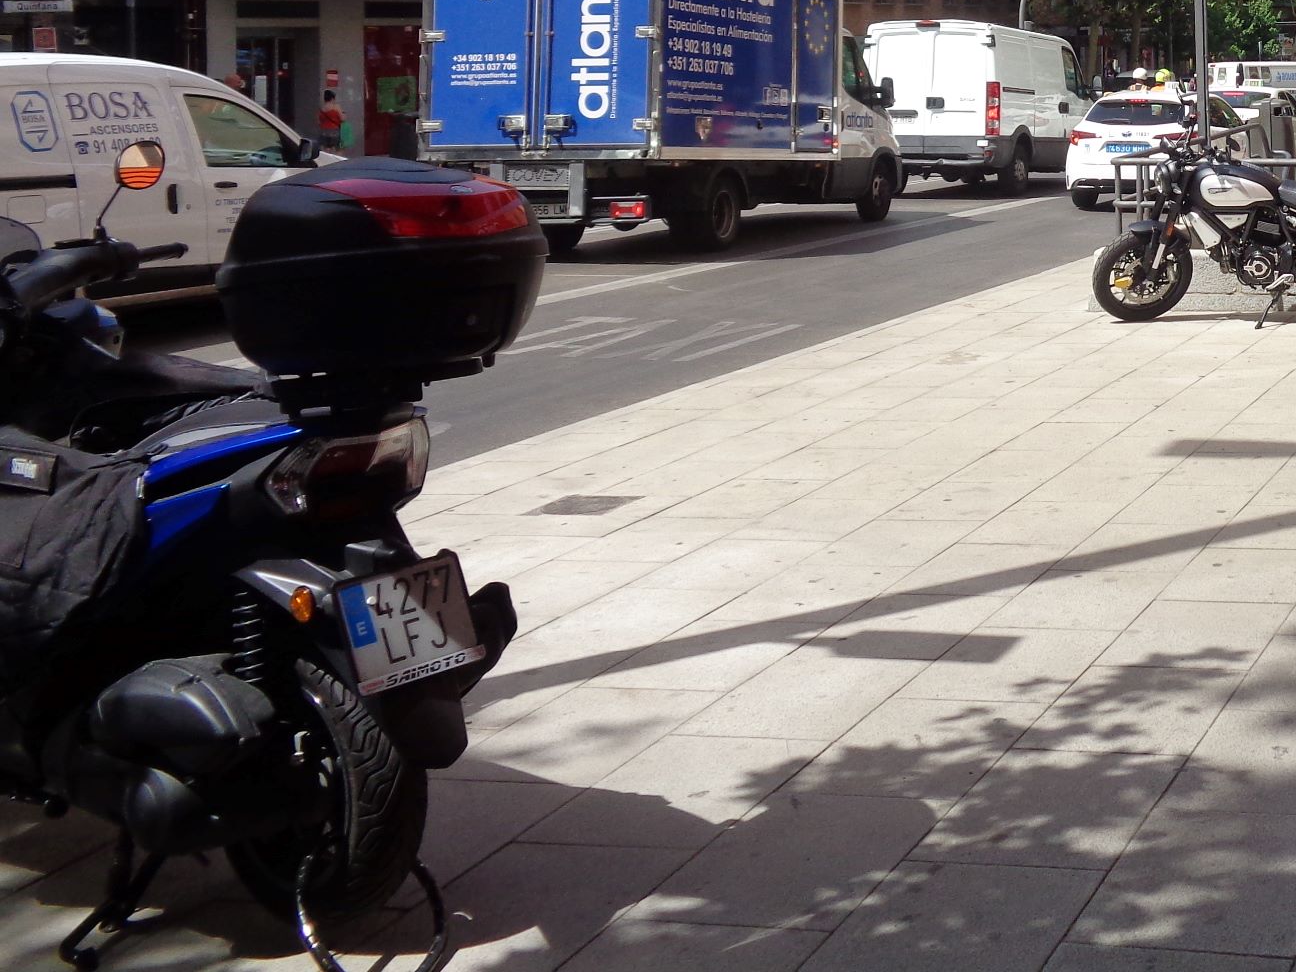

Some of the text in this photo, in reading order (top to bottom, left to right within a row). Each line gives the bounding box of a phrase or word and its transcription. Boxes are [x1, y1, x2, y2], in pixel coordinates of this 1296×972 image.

[17, 2, 58, 11] Quintana
[727, 7, 735, 19] la
[667, 15, 716, 34] Especialistas
[716, 26, 726, 36] en
[668, 37, 683, 52] +34
[684, 38, 699, 54] 902
[701, 40, 710, 55] 18
[712, 42, 721, 56] 19
[452, 53, 516, 62] +34 902 18 19 49
[667, 56, 734, 75] +351 263 037 706
[451, 63, 469, 71] +351
[486, 63, 501, 71] 037
[65, 91, 157, 122] BOSA
[22, 114, 46, 124] BOSA
[846, 111, 873, 128] atlanta
[90, 123, 159, 135] ASCENSORES
[93, 140, 107, 154] 91
[372, 564, 450, 619] 4277
[356, 621, 368, 636] E
[380, 611, 449, 664] LFJ
[385, 652, 467, 688] SAIMOTO
